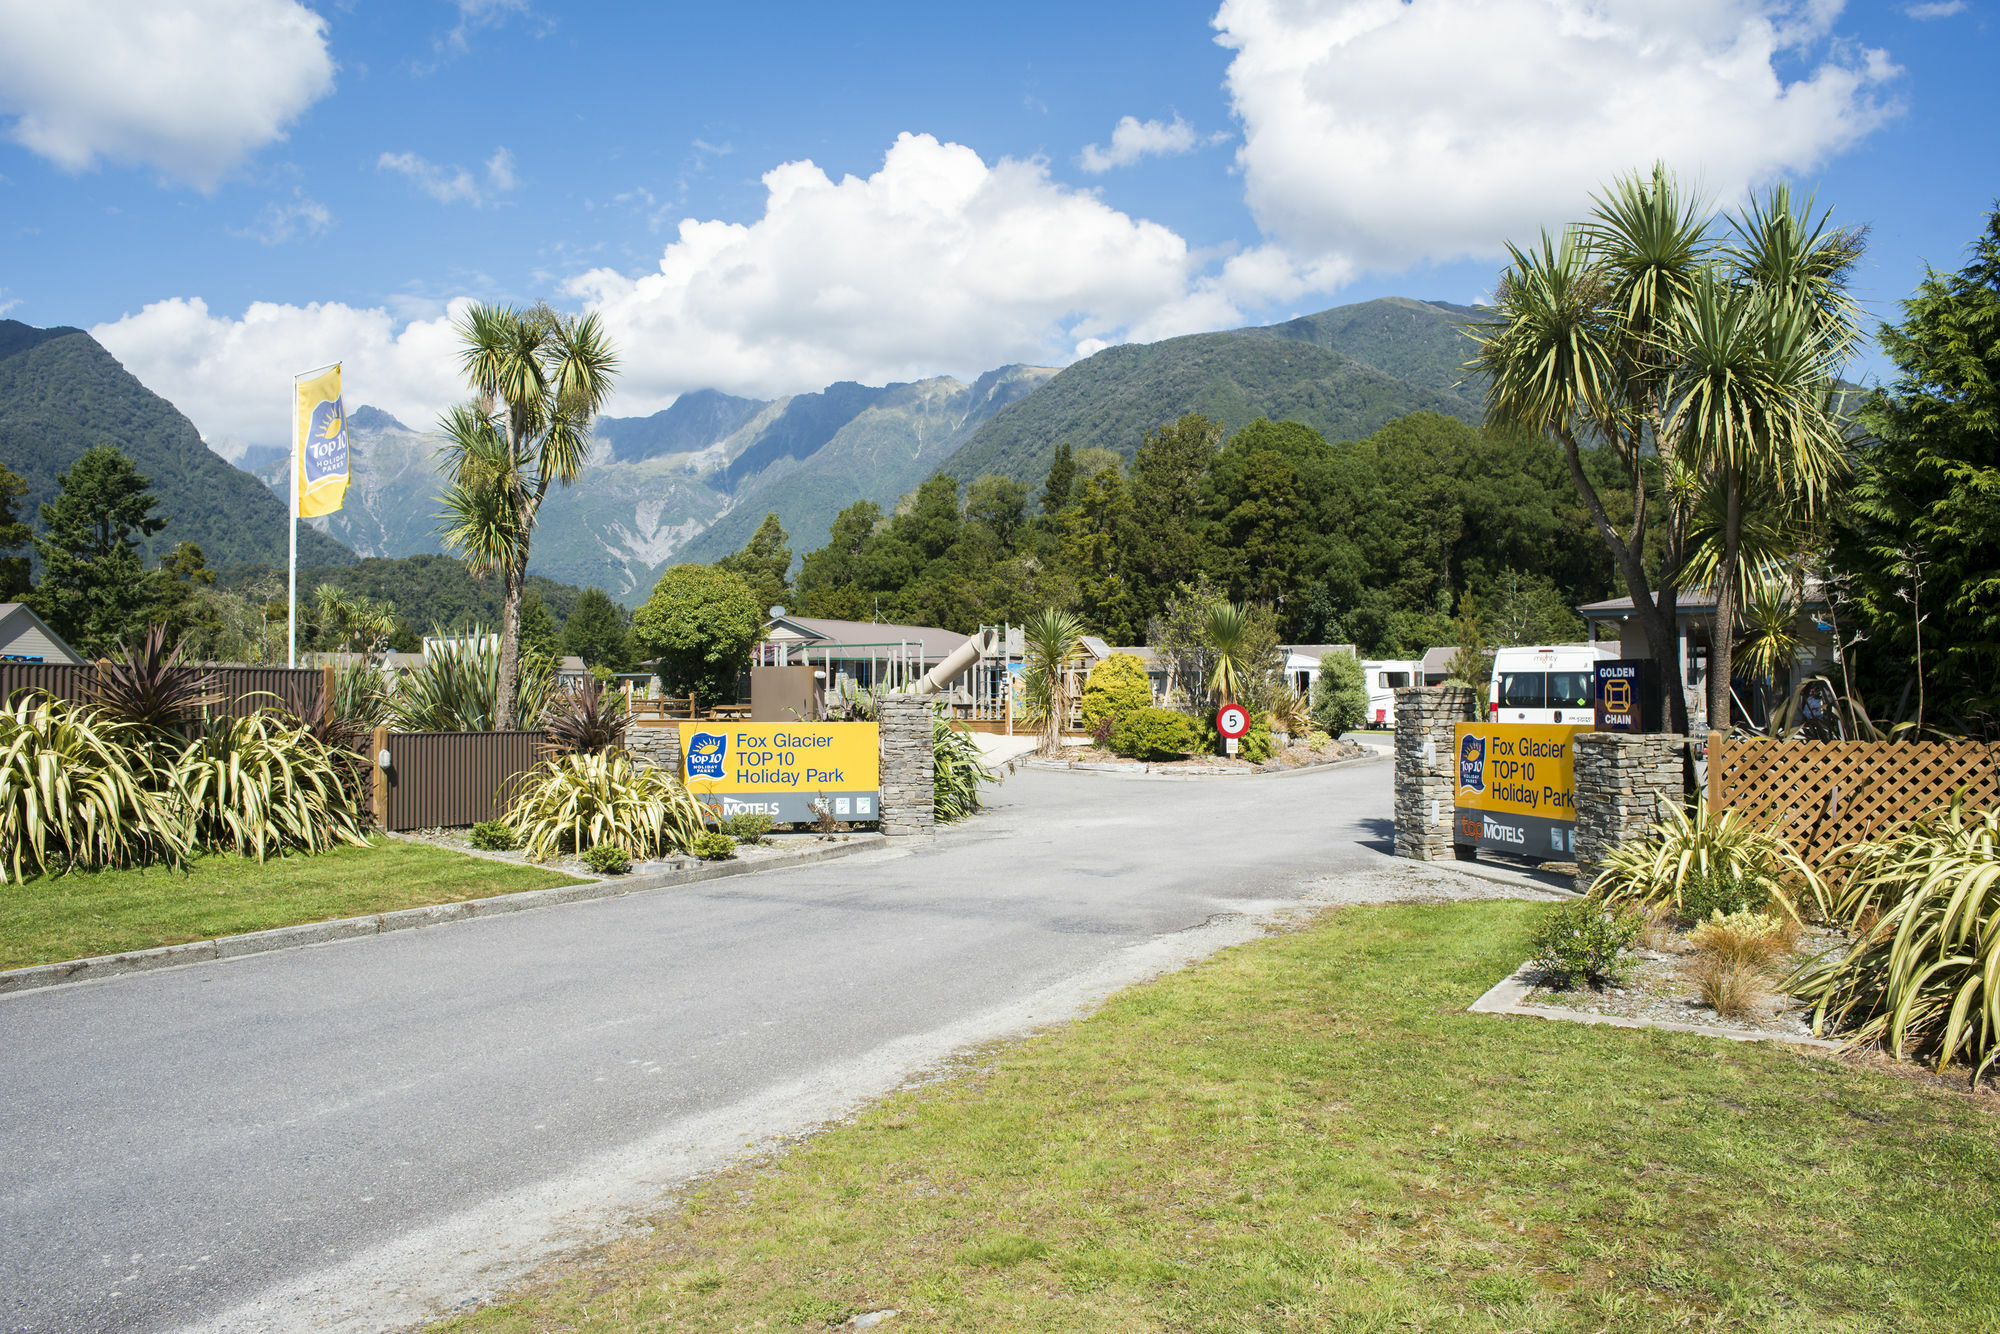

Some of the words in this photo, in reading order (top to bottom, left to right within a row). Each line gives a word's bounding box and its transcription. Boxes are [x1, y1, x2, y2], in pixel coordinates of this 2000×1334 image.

[310, 441, 336, 459] Top
[337, 430, 347, 451] 10
[316, 452, 346, 467] HOLIDAY
[322, 462, 344, 472] PARKS
[1533, 654, 1558, 664] mighty
[1600, 667, 1635, 678] GOLDEN
[1229, 715, 1238, 727] 5
[1604, 714, 1632, 725] CHAIN
[737, 733, 767, 748] Fox
[773, 733, 834, 748] Glacier
[1492, 736, 1514, 756] Fox
[1519, 737, 1566, 758] Glacier
[689, 754, 707, 764] Top
[708, 753, 722, 764] 10
[736, 751, 773, 766] TOP
[776, 751, 795, 766] 10
[1461, 760, 1473, 773] Top
[1473, 760, 1482, 773] 10
[1492, 760, 1518, 780] TOP
[1521, 761, 1535, 781] 10
[737, 768, 800, 786] Holiday
[806, 768, 844, 783] Park
[1492, 781, 1539, 809] Holiday
[1544, 786, 1575, 808] Park
[723, 802, 780, 816] MOTELS
[1461, 815, 1484, 842] top
[1483, 823, 1525, 844] MOTELS
